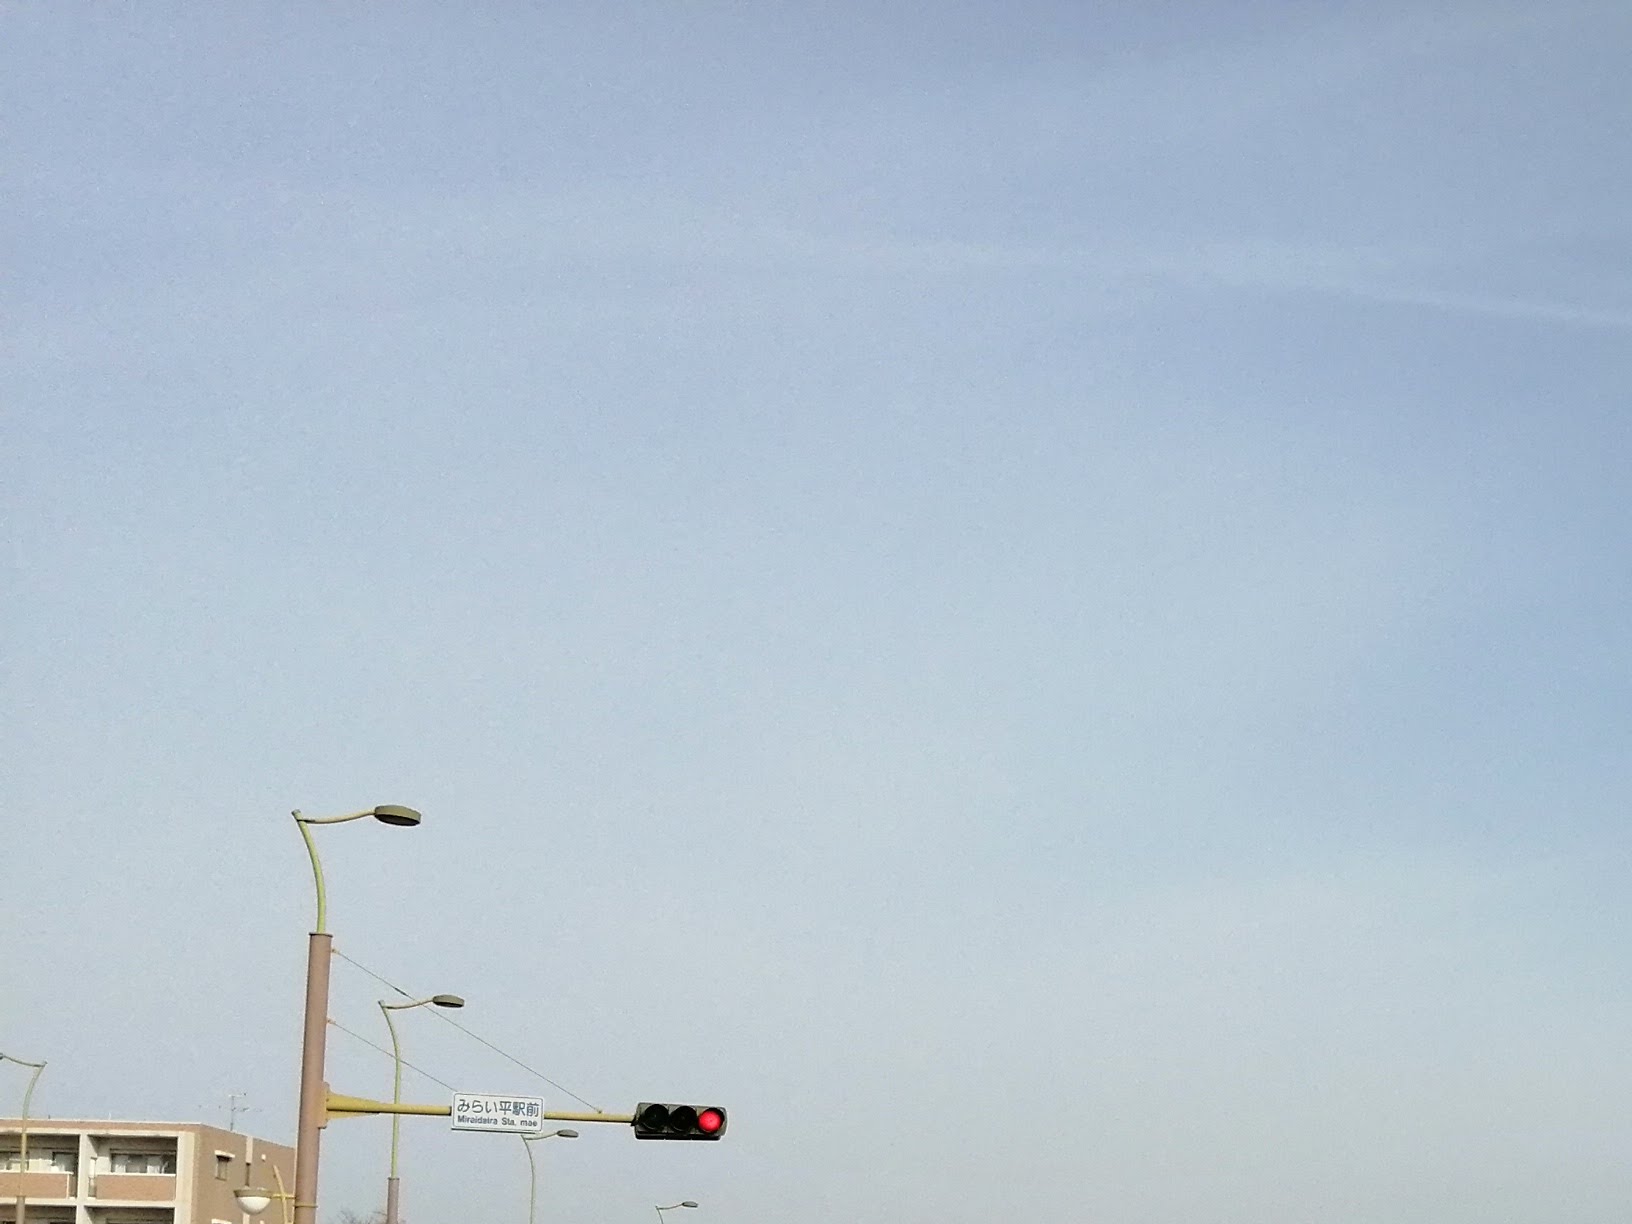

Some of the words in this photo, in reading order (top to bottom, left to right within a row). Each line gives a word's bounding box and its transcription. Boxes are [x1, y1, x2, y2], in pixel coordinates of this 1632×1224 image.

[457, 1099, 540, 1117] みらい平駅前
[501, 1117, 517, 1127] Sta.
[520, 1119, 538, 1127] mae
